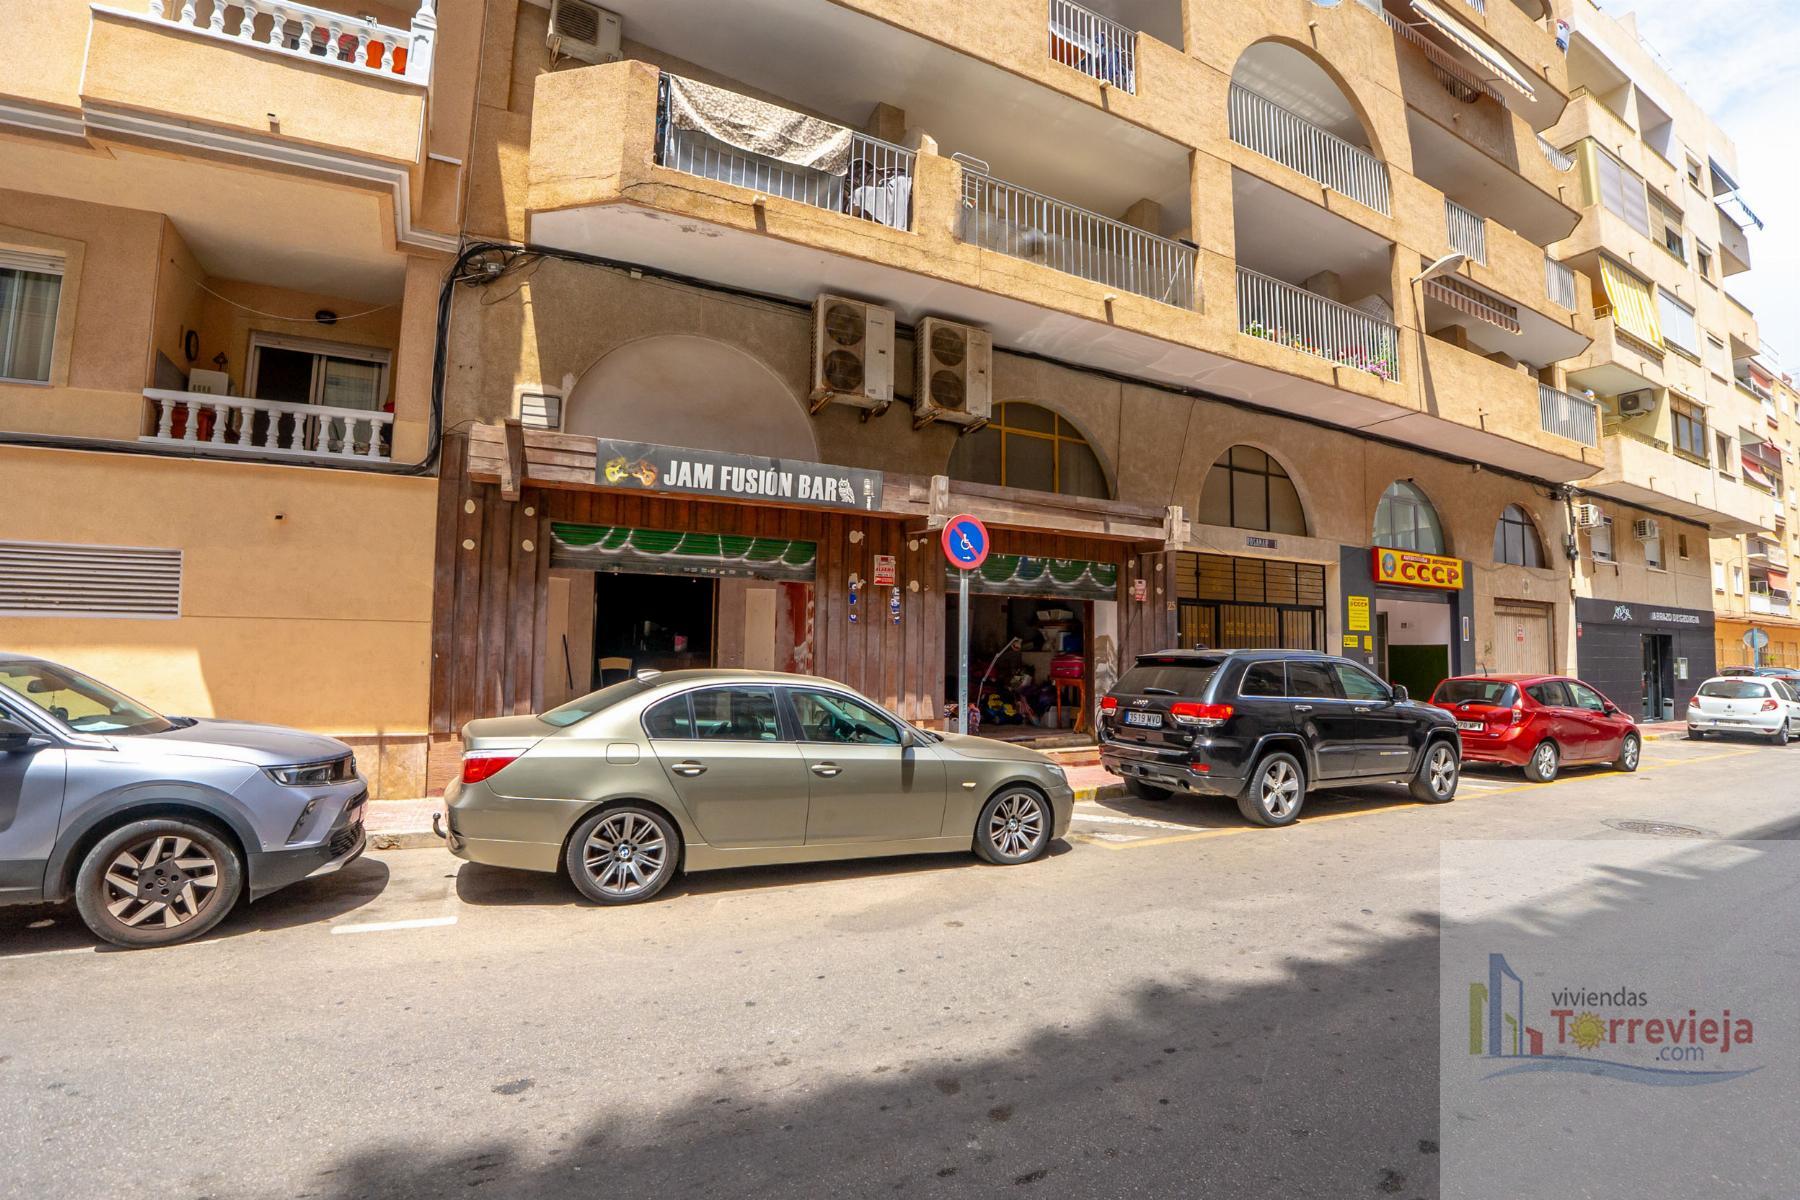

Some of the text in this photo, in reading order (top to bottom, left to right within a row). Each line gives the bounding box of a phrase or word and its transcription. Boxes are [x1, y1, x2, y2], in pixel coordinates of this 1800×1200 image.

[663, 460, 837, 502] JAM FUSIÓN BAR
[1401, 562, 1459, 584] CCCP
